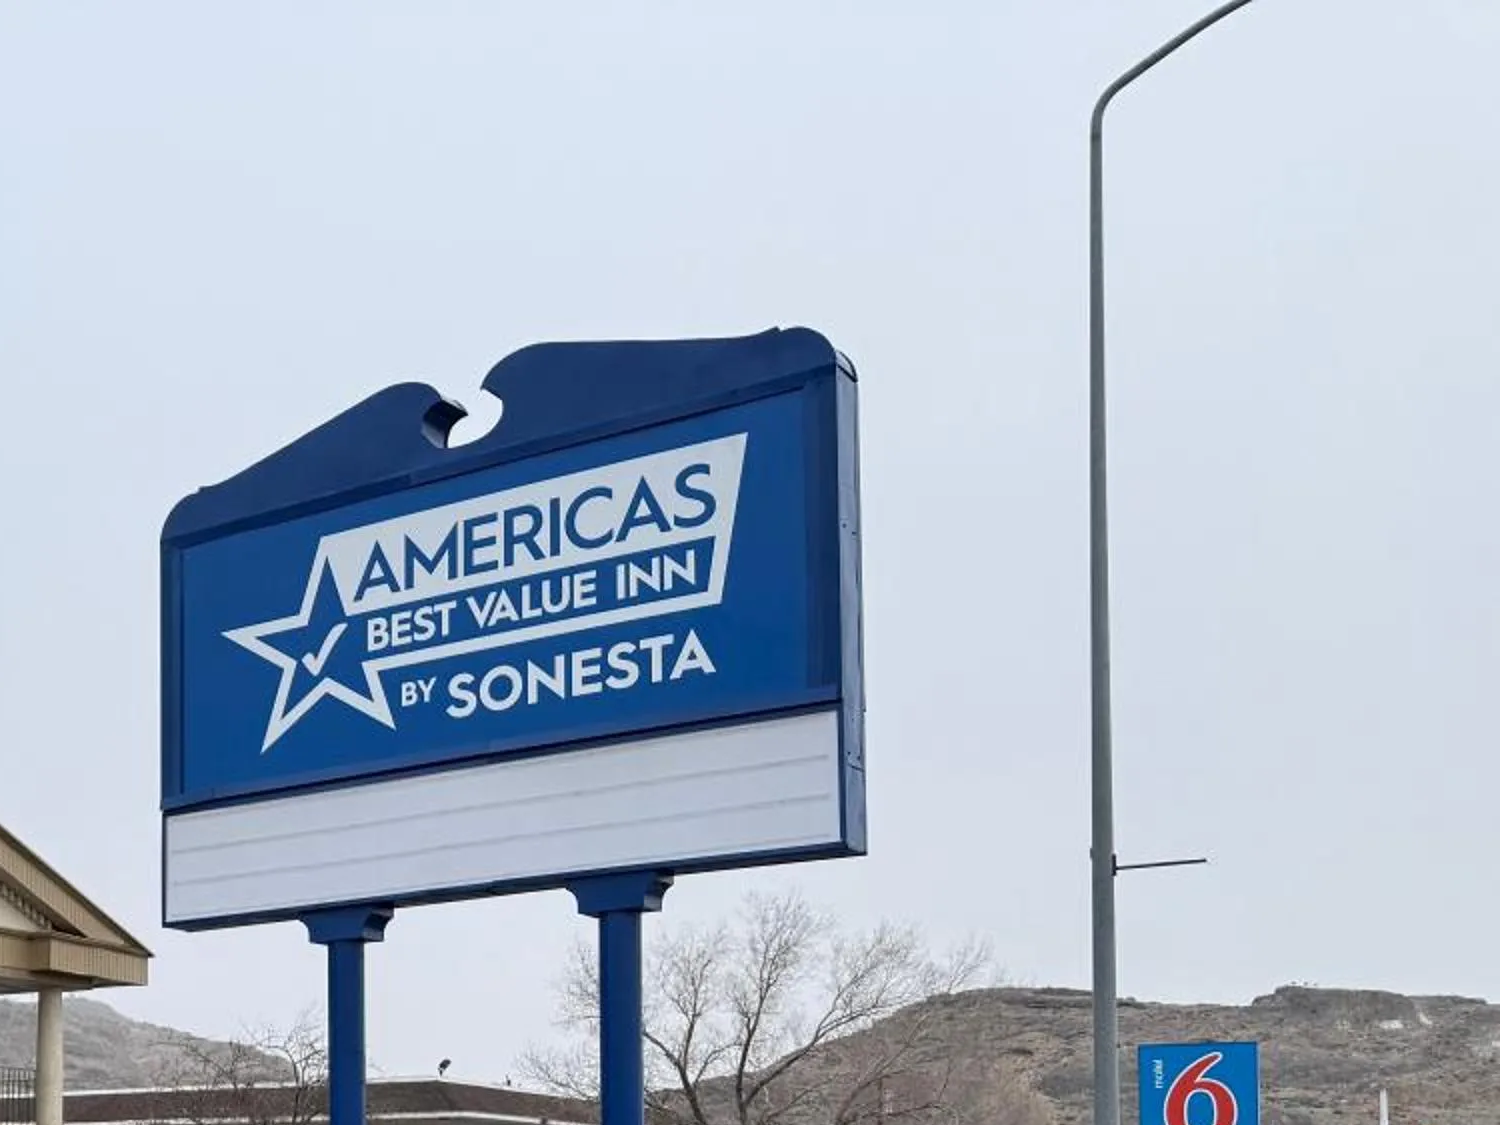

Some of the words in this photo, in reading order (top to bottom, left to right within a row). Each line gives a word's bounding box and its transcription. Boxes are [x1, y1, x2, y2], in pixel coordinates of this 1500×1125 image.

[353, 463, 717, 602] AMERICAS
[367, 600, 457, 652] BEST
[466, 570, 597, 628] VALUE
[616, 548, 696, 600] INN
[401, 677, 438, 708] BY
[446, 629, 717, 719] SONESTA
